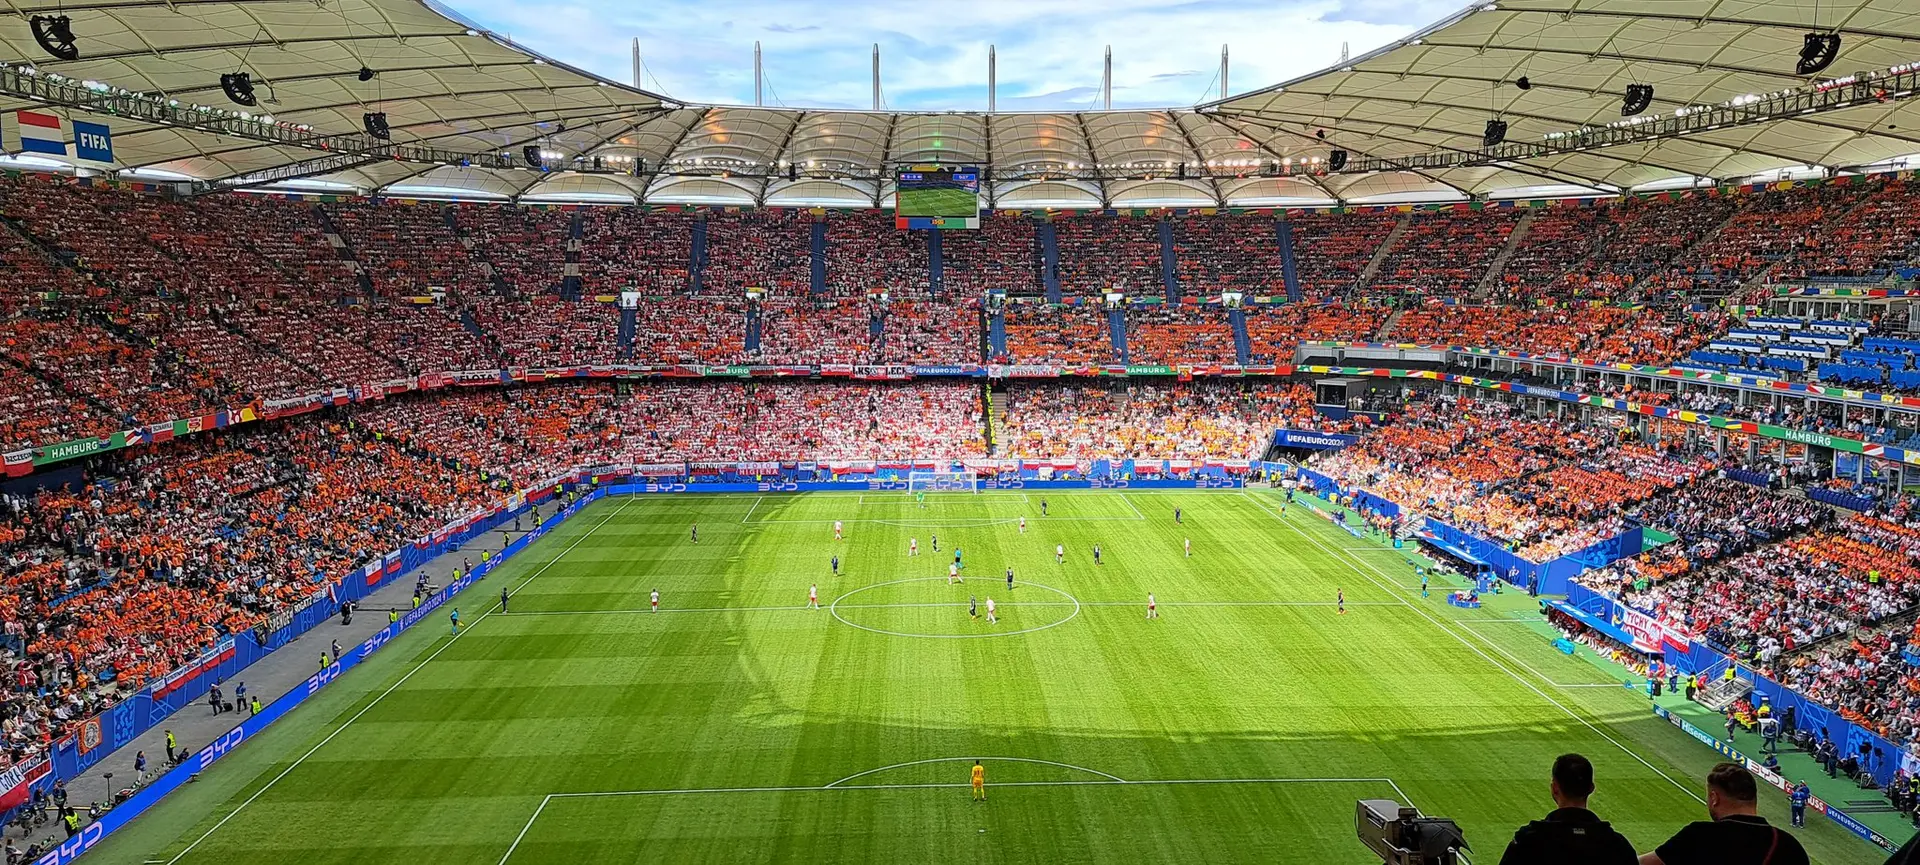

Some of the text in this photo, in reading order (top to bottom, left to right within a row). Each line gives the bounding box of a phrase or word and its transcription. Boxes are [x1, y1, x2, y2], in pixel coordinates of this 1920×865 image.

[80, 132, 108, 150] FIFA
[461, 373, 494, 381] FLOTA
[1785, 430, 1831, 446] HAMBURG
[51, 440, 98, 459] HAMBURG
[1627, 611, 1649, 628] TYCHY
[1681, 720, 1713, 746] Hisense
